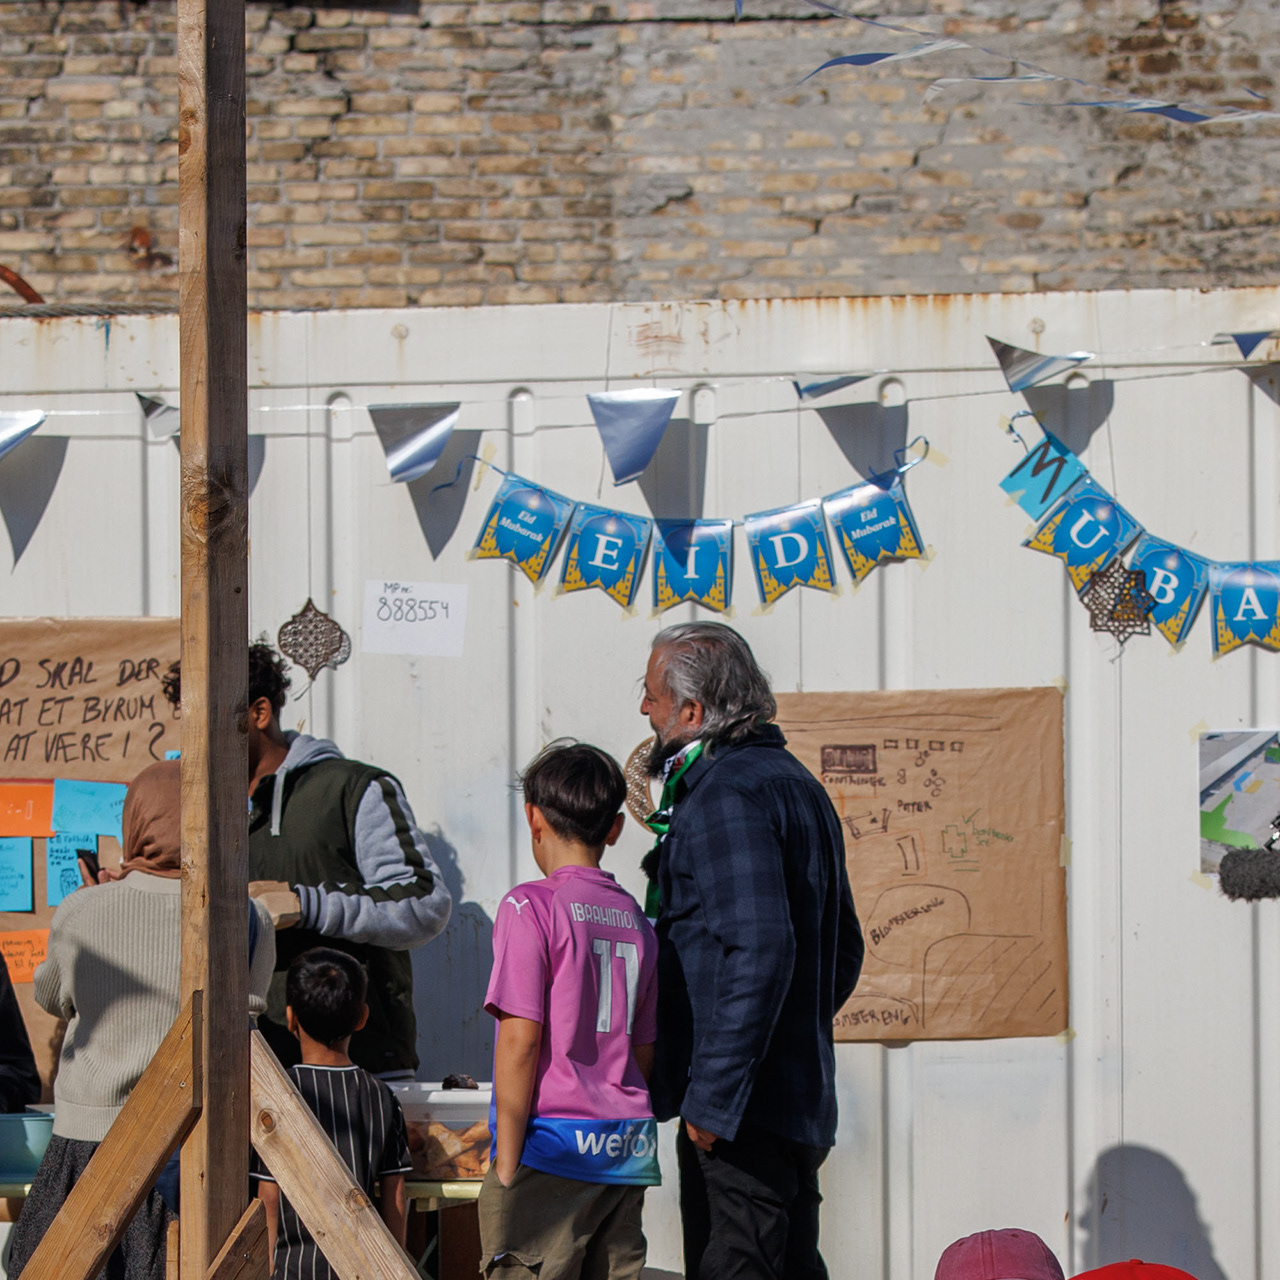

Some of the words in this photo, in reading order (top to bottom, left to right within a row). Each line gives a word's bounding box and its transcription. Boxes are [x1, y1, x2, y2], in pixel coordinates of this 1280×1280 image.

[517, 510, 538, 525] Eid
[851, 516, 896, 541] Mubarak
[860, 508, 878, 523] Eid
[498, 517, 544, 542] Mubarak
[377, 596, 449, 622] 888554
[36, 656, 97, 690] SKAL
[116, 657, 160, 687] DER
[37, 696, 75, 726] ET
[82, 694, 156, 725] BYRUM
[4, 730, 38, 762] AT
[45, 731, 113, 763] VÆRE
[592, 937, 639, 1035] 11
